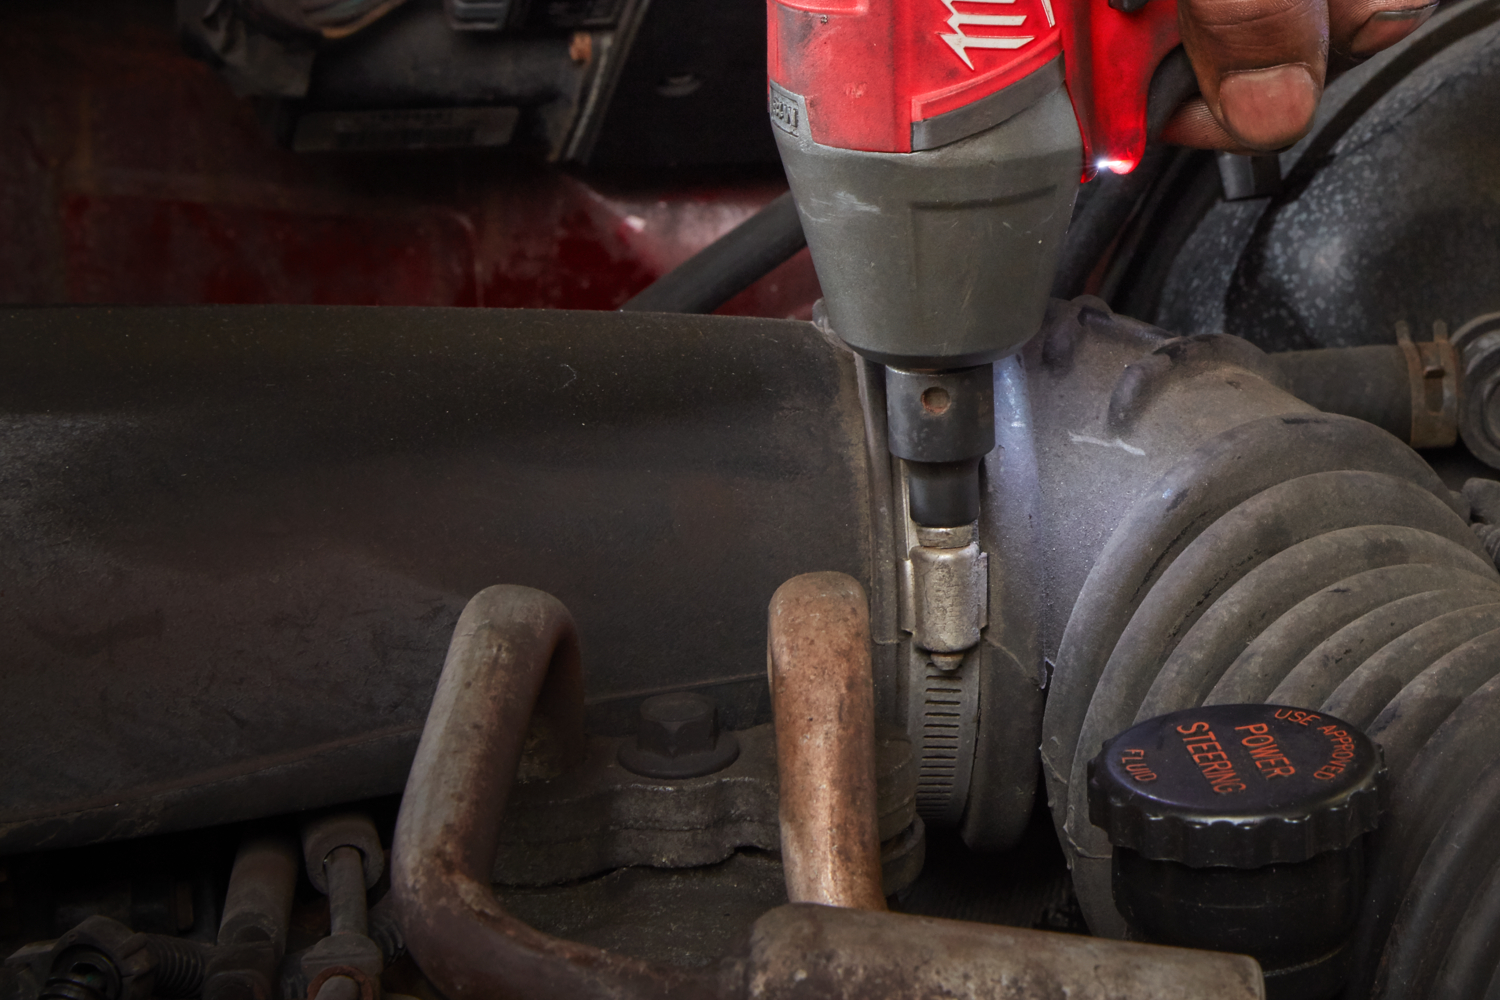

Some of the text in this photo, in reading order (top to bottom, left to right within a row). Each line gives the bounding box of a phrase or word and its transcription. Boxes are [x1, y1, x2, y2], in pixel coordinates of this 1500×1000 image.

[1121, 748, 1158, 782] FLUID
[1176, 721, 1247, 795] STEERING
[1235, 722, 1296, 780] POWER
[1274, 708, 1355, 781] USE APPROVED
